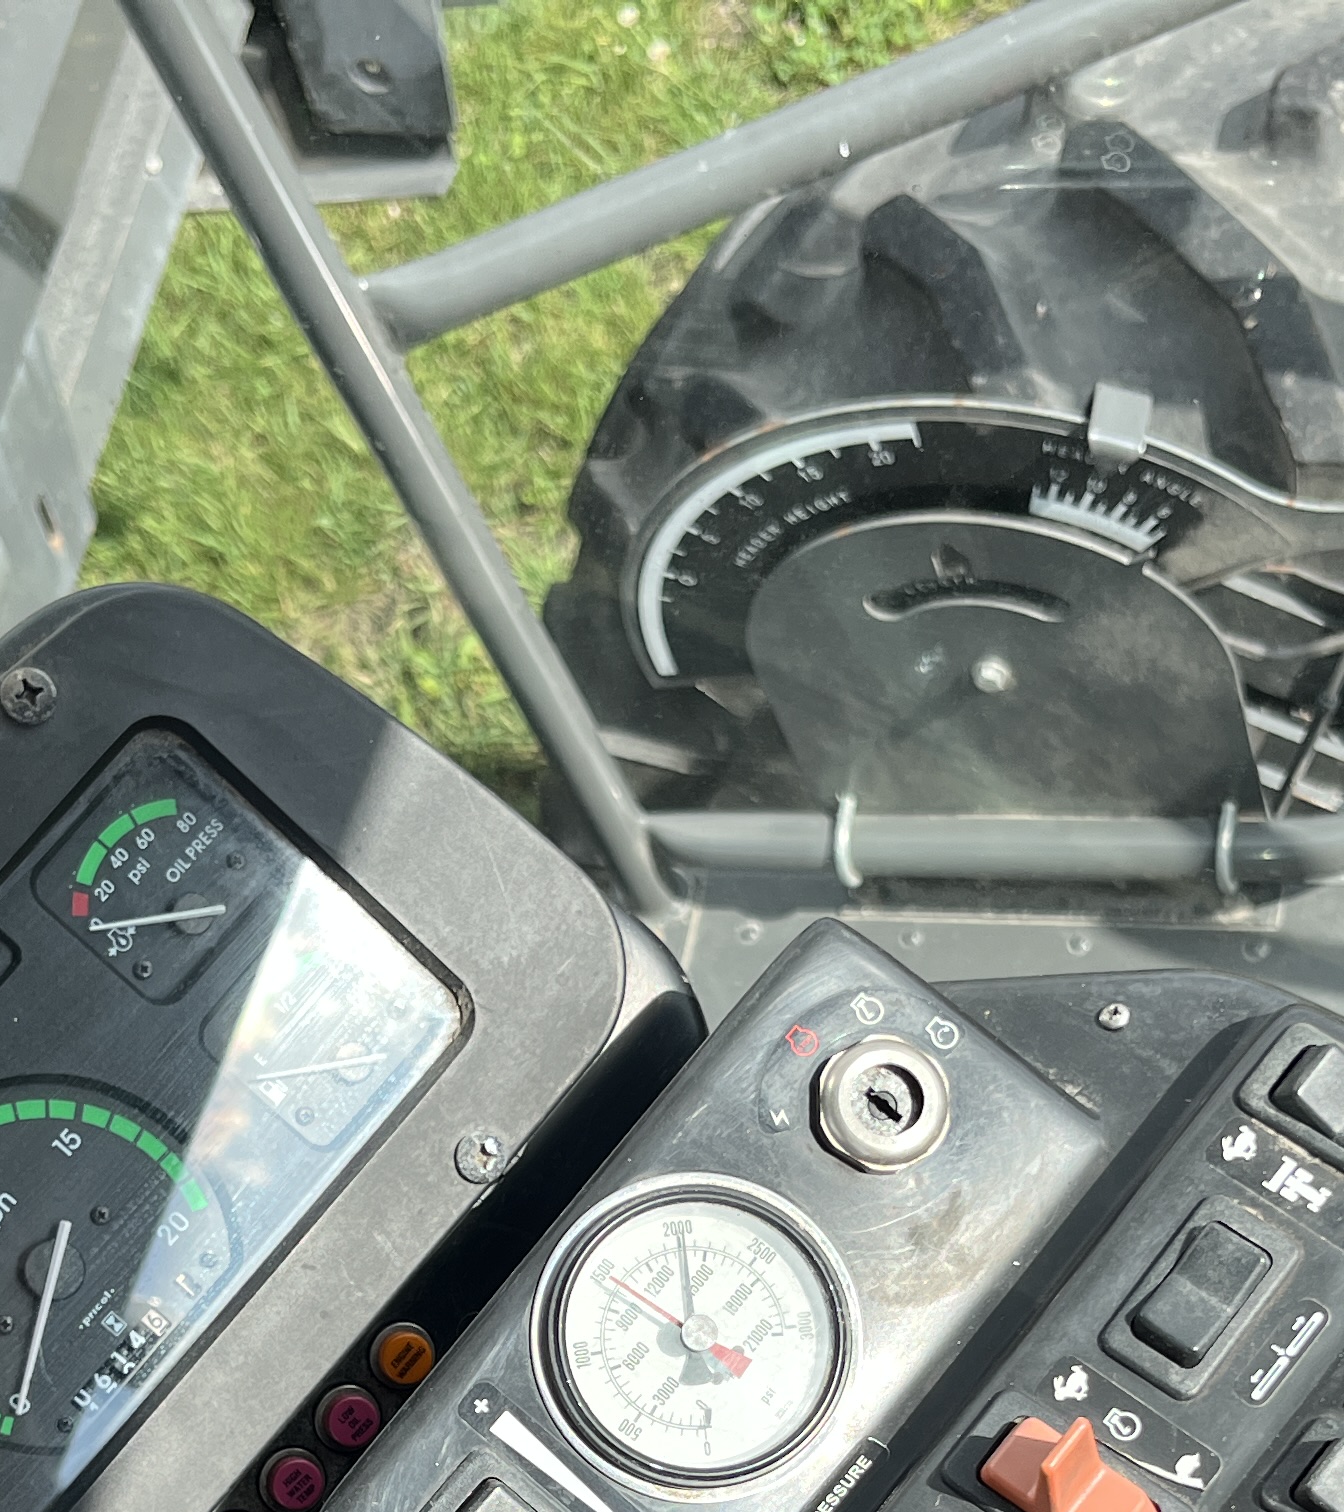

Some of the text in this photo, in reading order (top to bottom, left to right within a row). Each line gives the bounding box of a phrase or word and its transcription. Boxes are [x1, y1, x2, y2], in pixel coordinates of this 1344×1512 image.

[867, 449, 896, 467] 20
[738, 493, 765, 511] 10
[176, 812, 197, 833] 80
[135, 828, 155, 849] 60
[166, 819, 224, 882] OIL PRESS
[110, 848, 129, 869] 40
[128, 857, 151, 885] psi
[94, 880, 115, 902] 20
[52, 1128, 82, 1157] 15
[157, 1211, 189, 1246] 20
[662, 1219, 693, 1238] 2000
[747, 1238, 776, 1264] 2500
[589, 1258, 616, 1285] 1500
[643, 1265, 675, 1298] 12000
[687, 1263, 714, 1297] 5000
[722, 1283, 753, 1316] 18000
[615, 1302, 643, 1332] 9000
[796, 1311, 814, 1341] 3000
[742, 1319, 774, 1354] 21000
[572, 1341, 589, 1370] 1000
[622, 1341, 650, 1371] 6000
[652, 1375, 680, 1407] 3000
[760, 1387, 777, 1406] psi
[9, 1393, 31, 1415] 0
[338, 1405, 355, 1424] LOW
[348, 1418, 360, 1429] OIL
[351, 1418, 374, 1442] PRESS
[618, 1418, 643, 1441] 500
[703, 1442, 711, 1456] 0
[282, 1469, 302, 1488] HIGH
[286, 1473, 313, 1498] WATER
